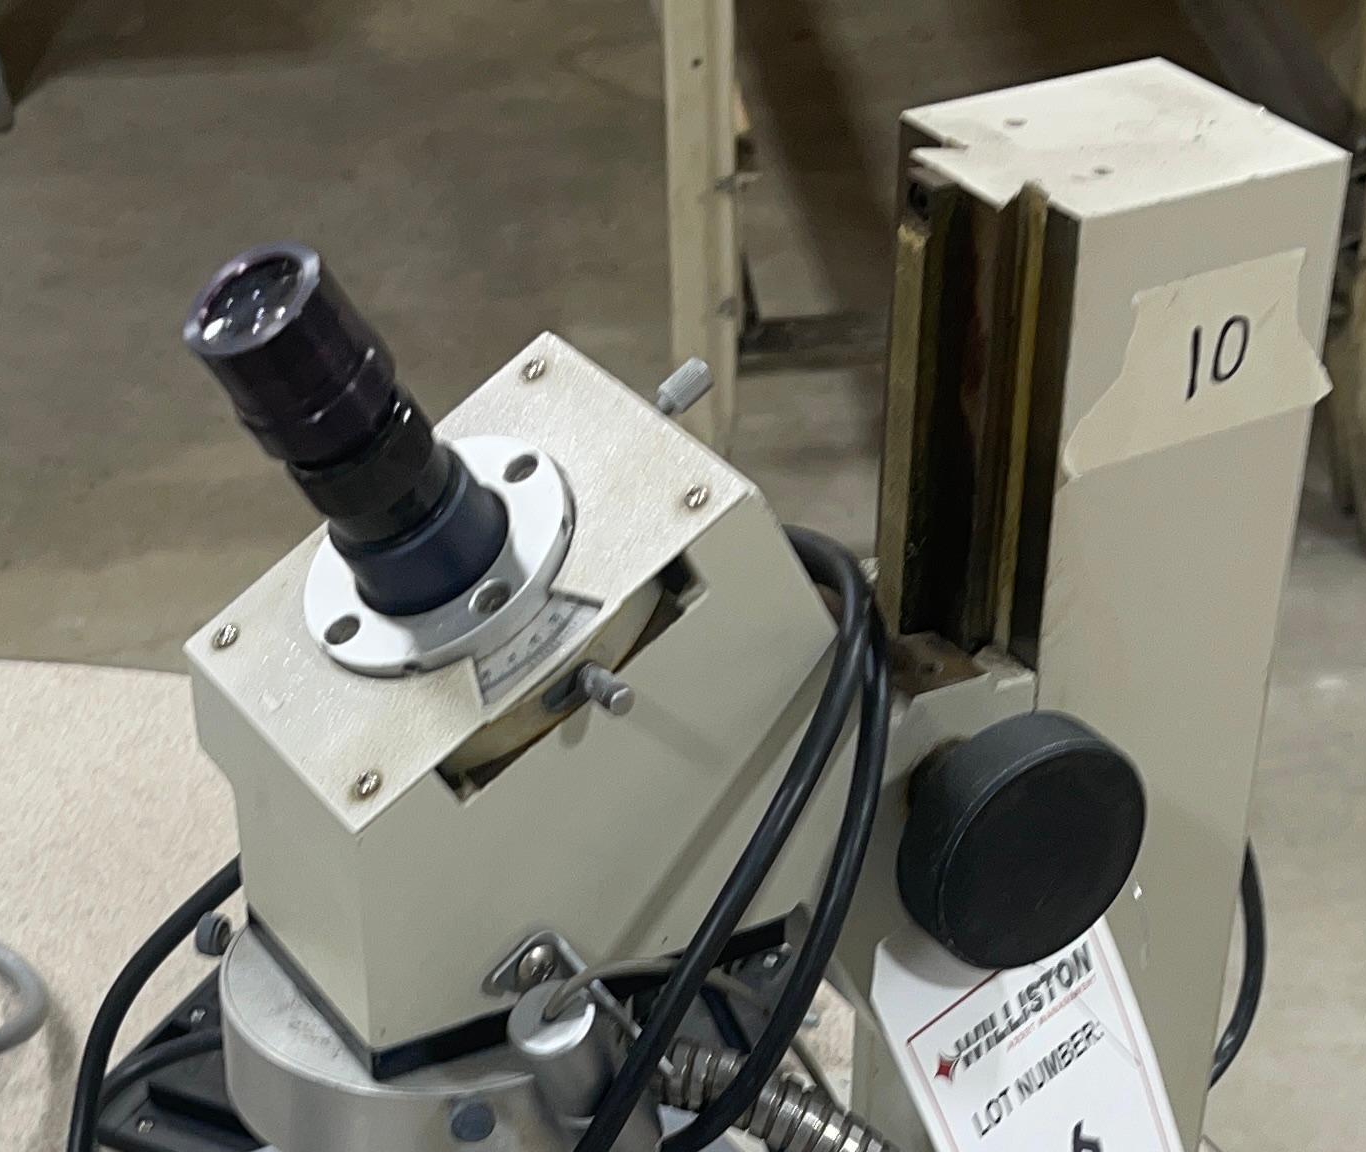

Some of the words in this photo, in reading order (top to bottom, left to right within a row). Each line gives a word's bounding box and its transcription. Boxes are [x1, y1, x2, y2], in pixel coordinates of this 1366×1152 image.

[1185, 314, 1251, 403] 10
[947, 940, 1095, 1071] WILLISTON
[970, 1086, 1015, 1140] LOT
[1014, 1020, 1106, 1106] NUMBER:
